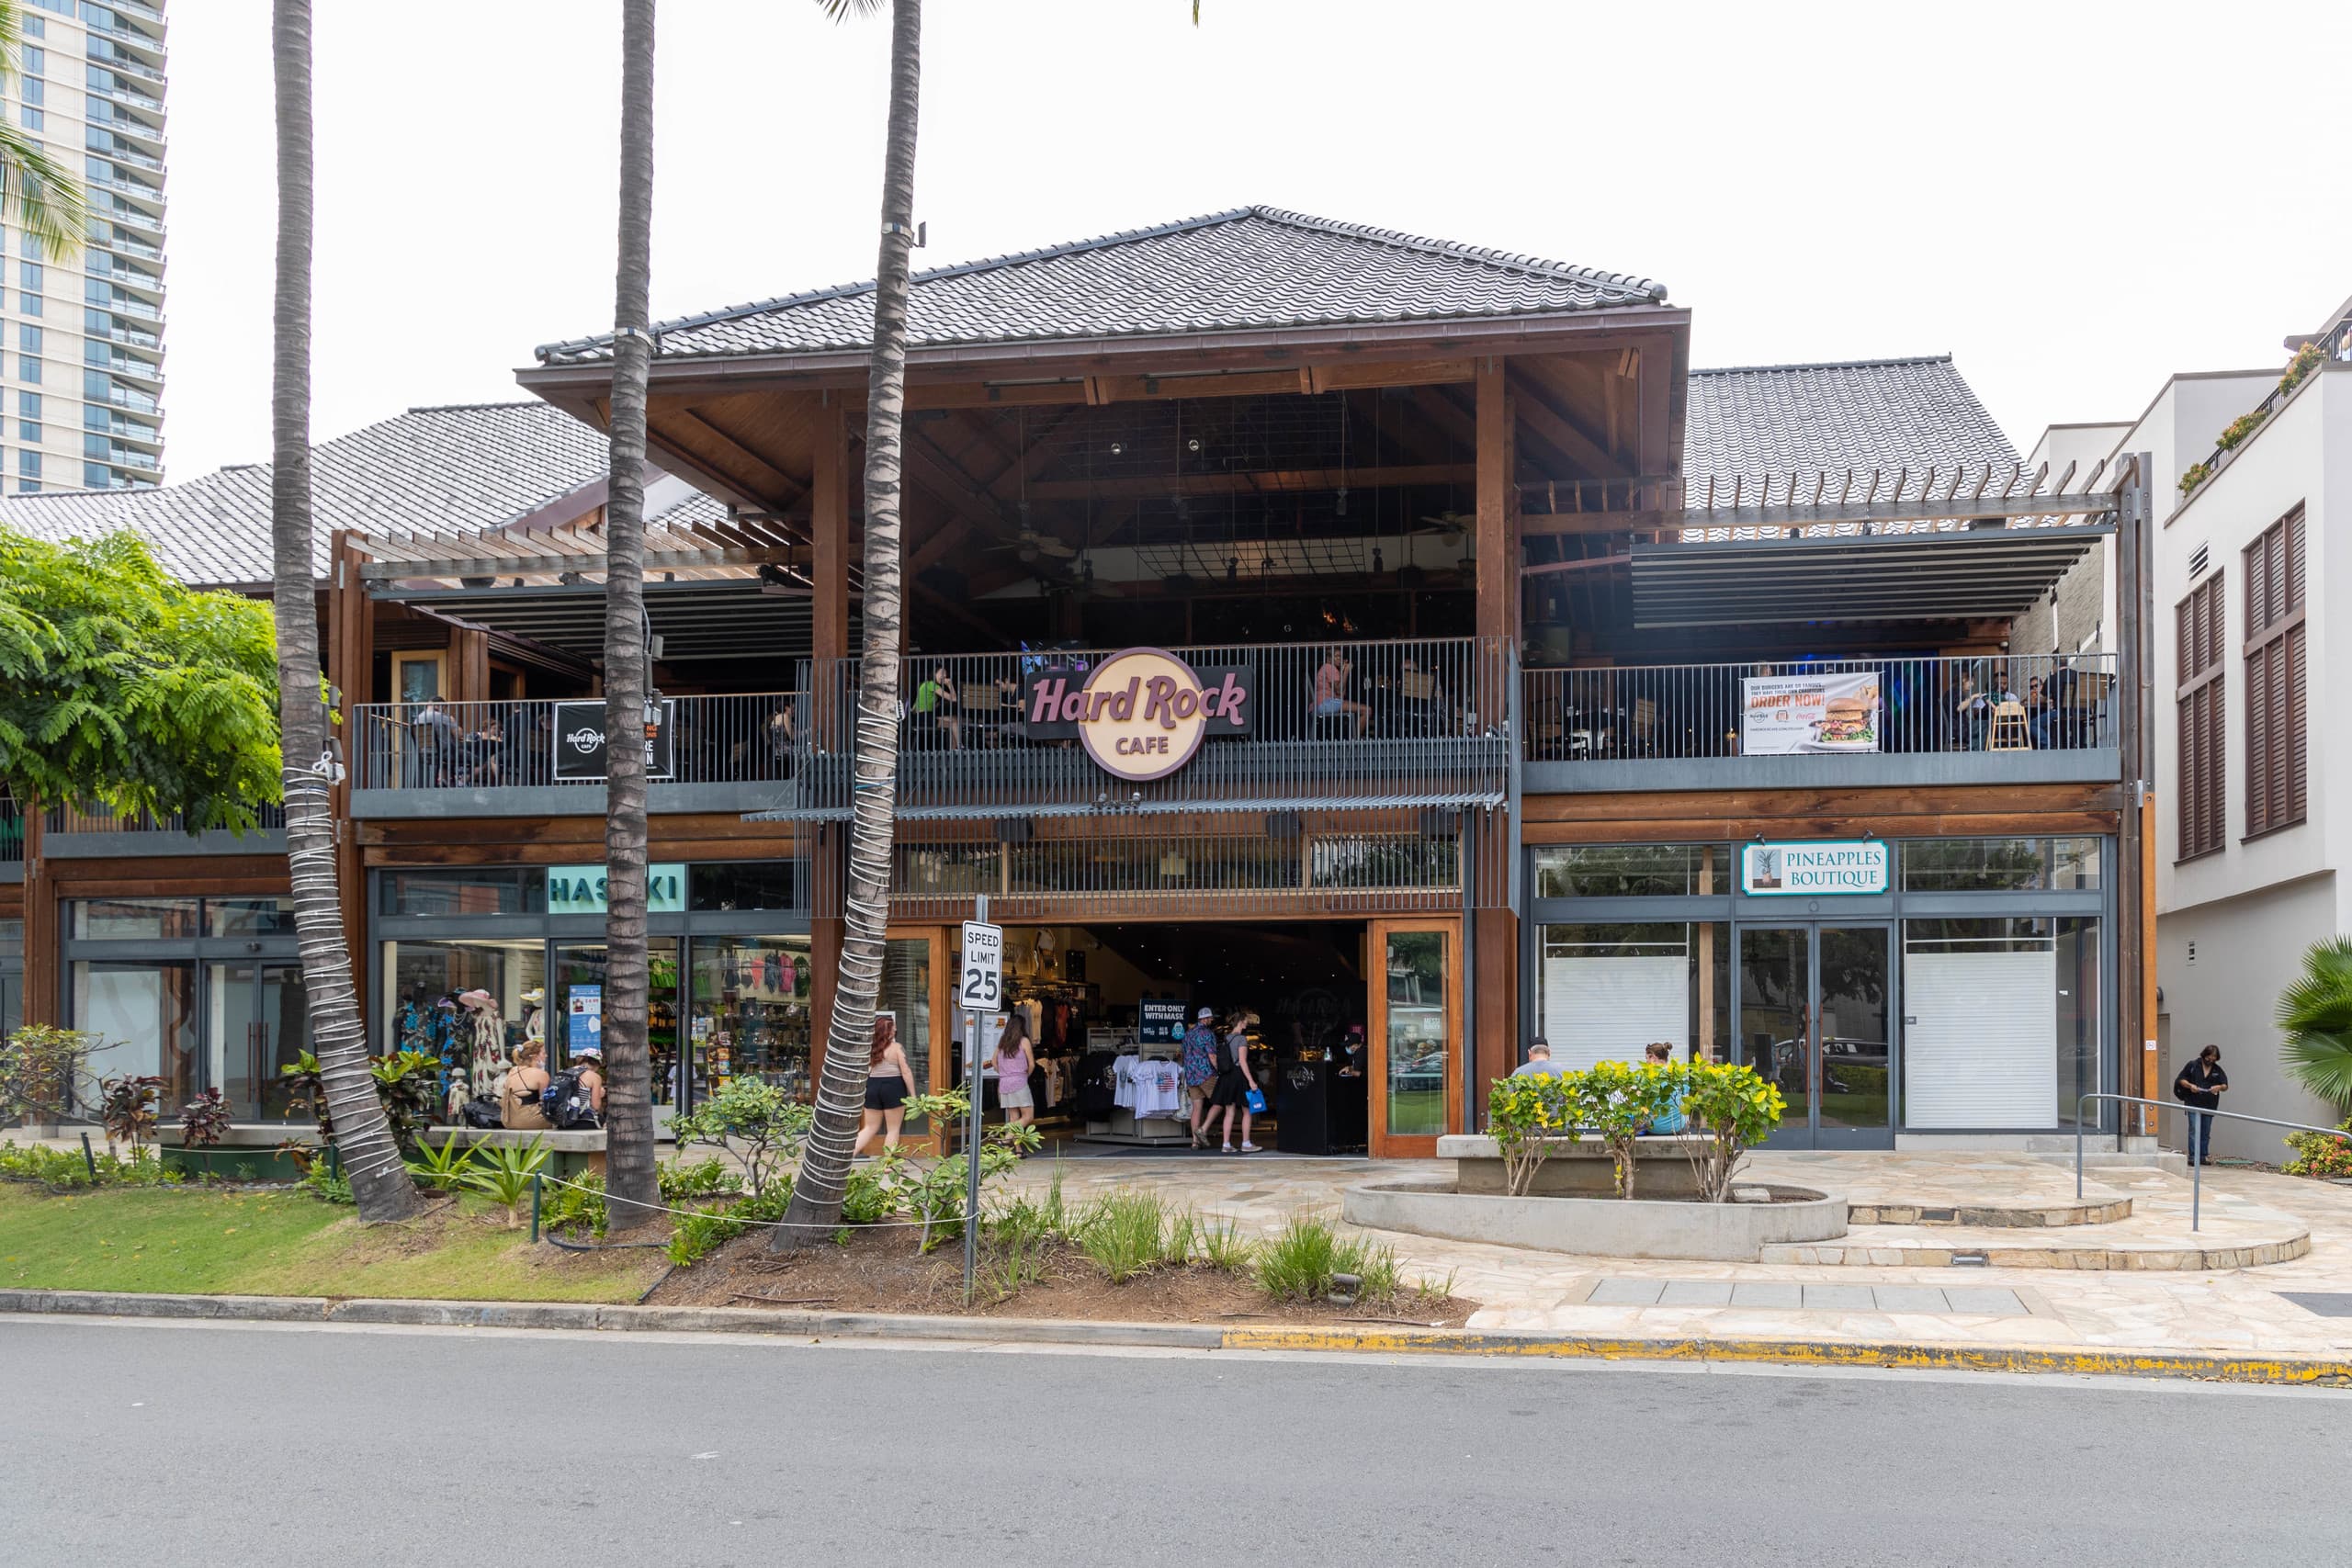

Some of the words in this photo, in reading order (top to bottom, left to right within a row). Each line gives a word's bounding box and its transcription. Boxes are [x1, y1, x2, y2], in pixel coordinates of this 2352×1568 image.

[1031, 676, 1140, 722] Hard
[1144, 672, 1247, 729] Rock
[1750, 694, 1791, 708] ORDER
[1794, 694, 1825, 706] NOW!
[567, 733, 587, 743] Hard
[586, 732, 605, 744] Rock
[1115, 736, 1169, 755] CAFE
[1786, 851, 1882, 867] PINEAPPLES
[1791, 870, 1878, 888] BOUTIQUE
[549, 876, 676, 902] HASKI
[967, 931, 1000, 947] SPEED
[970, 950, 996, 964] LIMIT
[965, 968, 998, 1001] 25
[1144, 1004, 1167, 1012] ENTER
[1164, 1012, 1184, 1021] MASK
